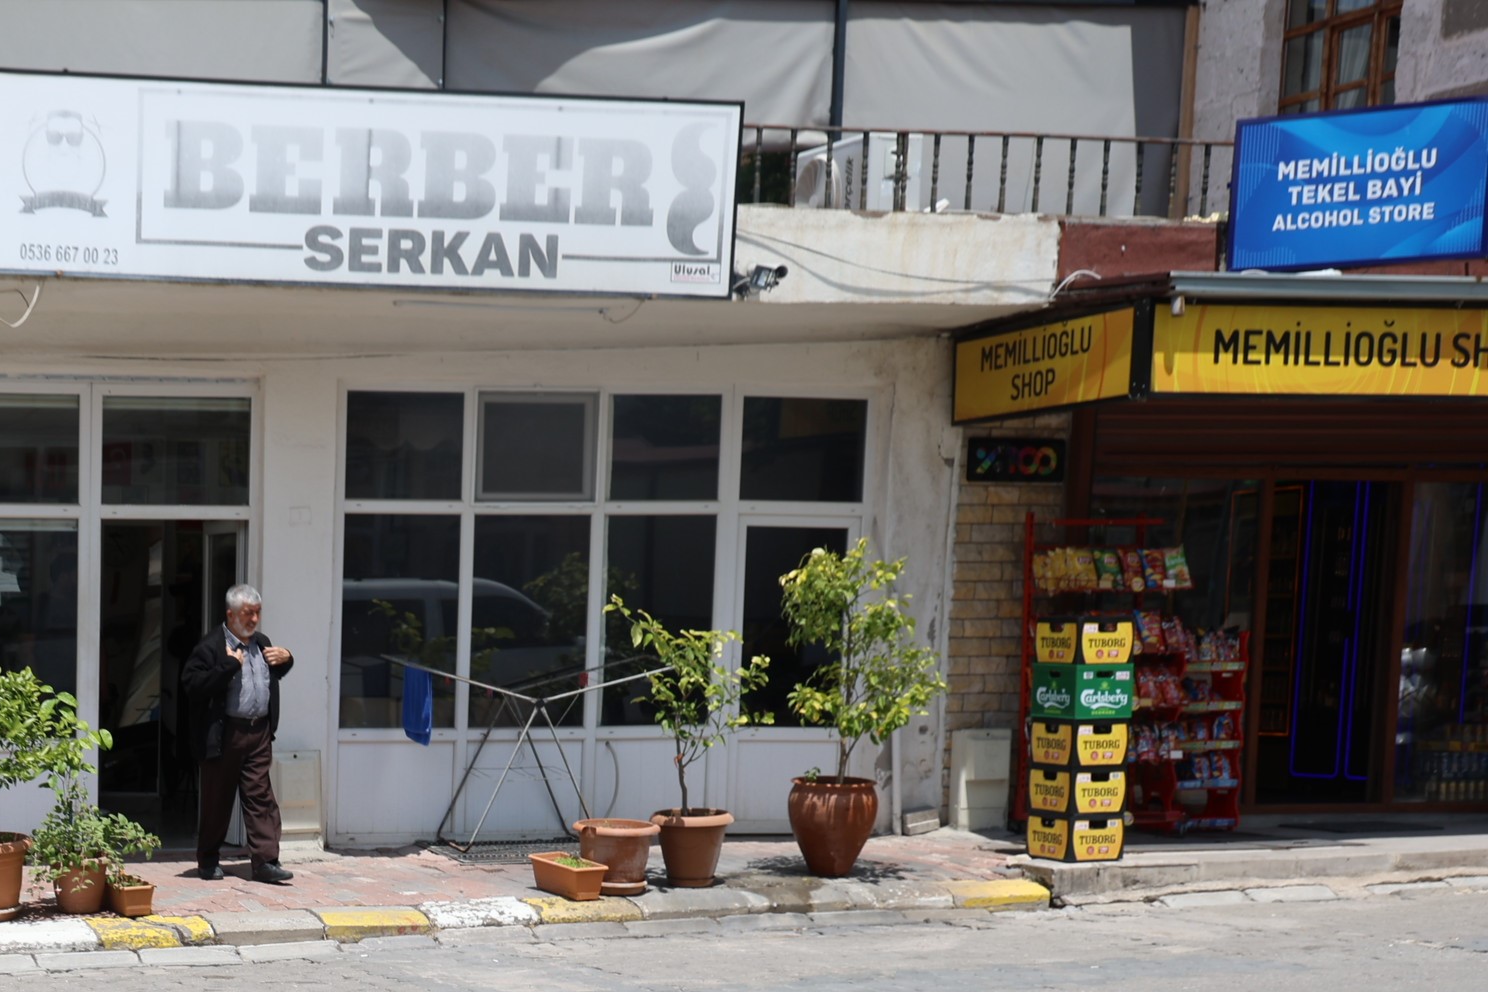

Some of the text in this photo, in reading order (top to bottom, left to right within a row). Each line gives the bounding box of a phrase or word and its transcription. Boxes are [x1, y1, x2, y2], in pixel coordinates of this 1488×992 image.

[163, 120, 654, 227] BERBER
[1277, 146, 1438, 181] MEMİLLİOĞLU
[1288, 170, 1423, 206] TEKEL BAYİ
[1272, 202, 1436, 232] ALCOHOL STORE
[20, 243, 119, 265] 0536 667 00 23
[303, 224, 559, 279] SERKAN
[981, 321, 1092, 372] MEMİLLİOĞLU
[1213, 320, 1442, 367] MEMİLLİOĞLU
[1010, 368, 1056, 401] SHOP
[1040, 636, 1072, 649] TUBORG
[1088, 637, 1126, 648] TUBORG
[1036, 687, 1071, 709] Carlsberg
[1080, 689, 1128, 709] Carlsberg
[1036, 737, 1067, 750] TUBORG
[1083, 739, 1120, 750] TUBORG
[1034, 783, 1064, 798] TUBORG
[1081, 787, 1119, 797] TUBORG
[1032, 830, 1062, 845] TUBORG
[1079, 834, 1116, 845] TUBORG
